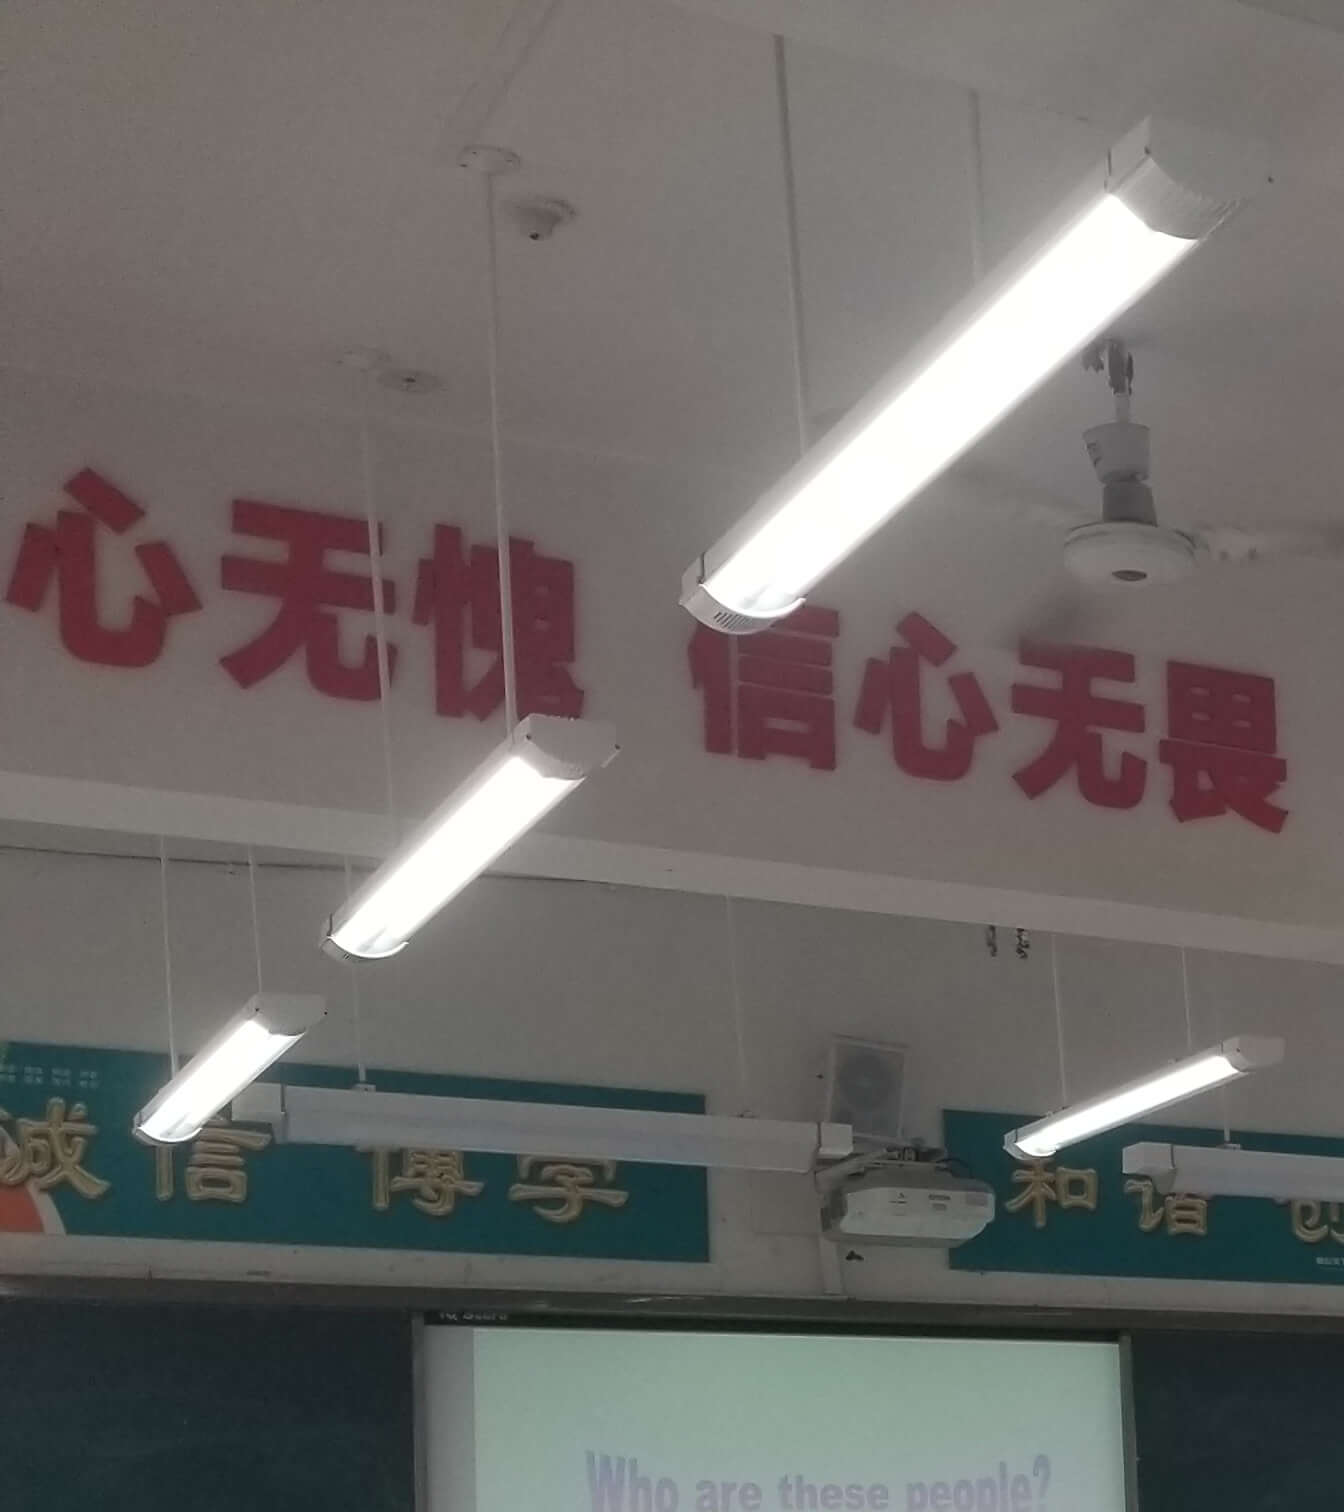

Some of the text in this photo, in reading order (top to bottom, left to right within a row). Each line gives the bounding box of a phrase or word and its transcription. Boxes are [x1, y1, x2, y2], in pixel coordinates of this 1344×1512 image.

[6, 467, 588, 721] 心无愧
[687, 603, 1289, 835] 信心无畏
[777, 1474, 889, 1512] these
